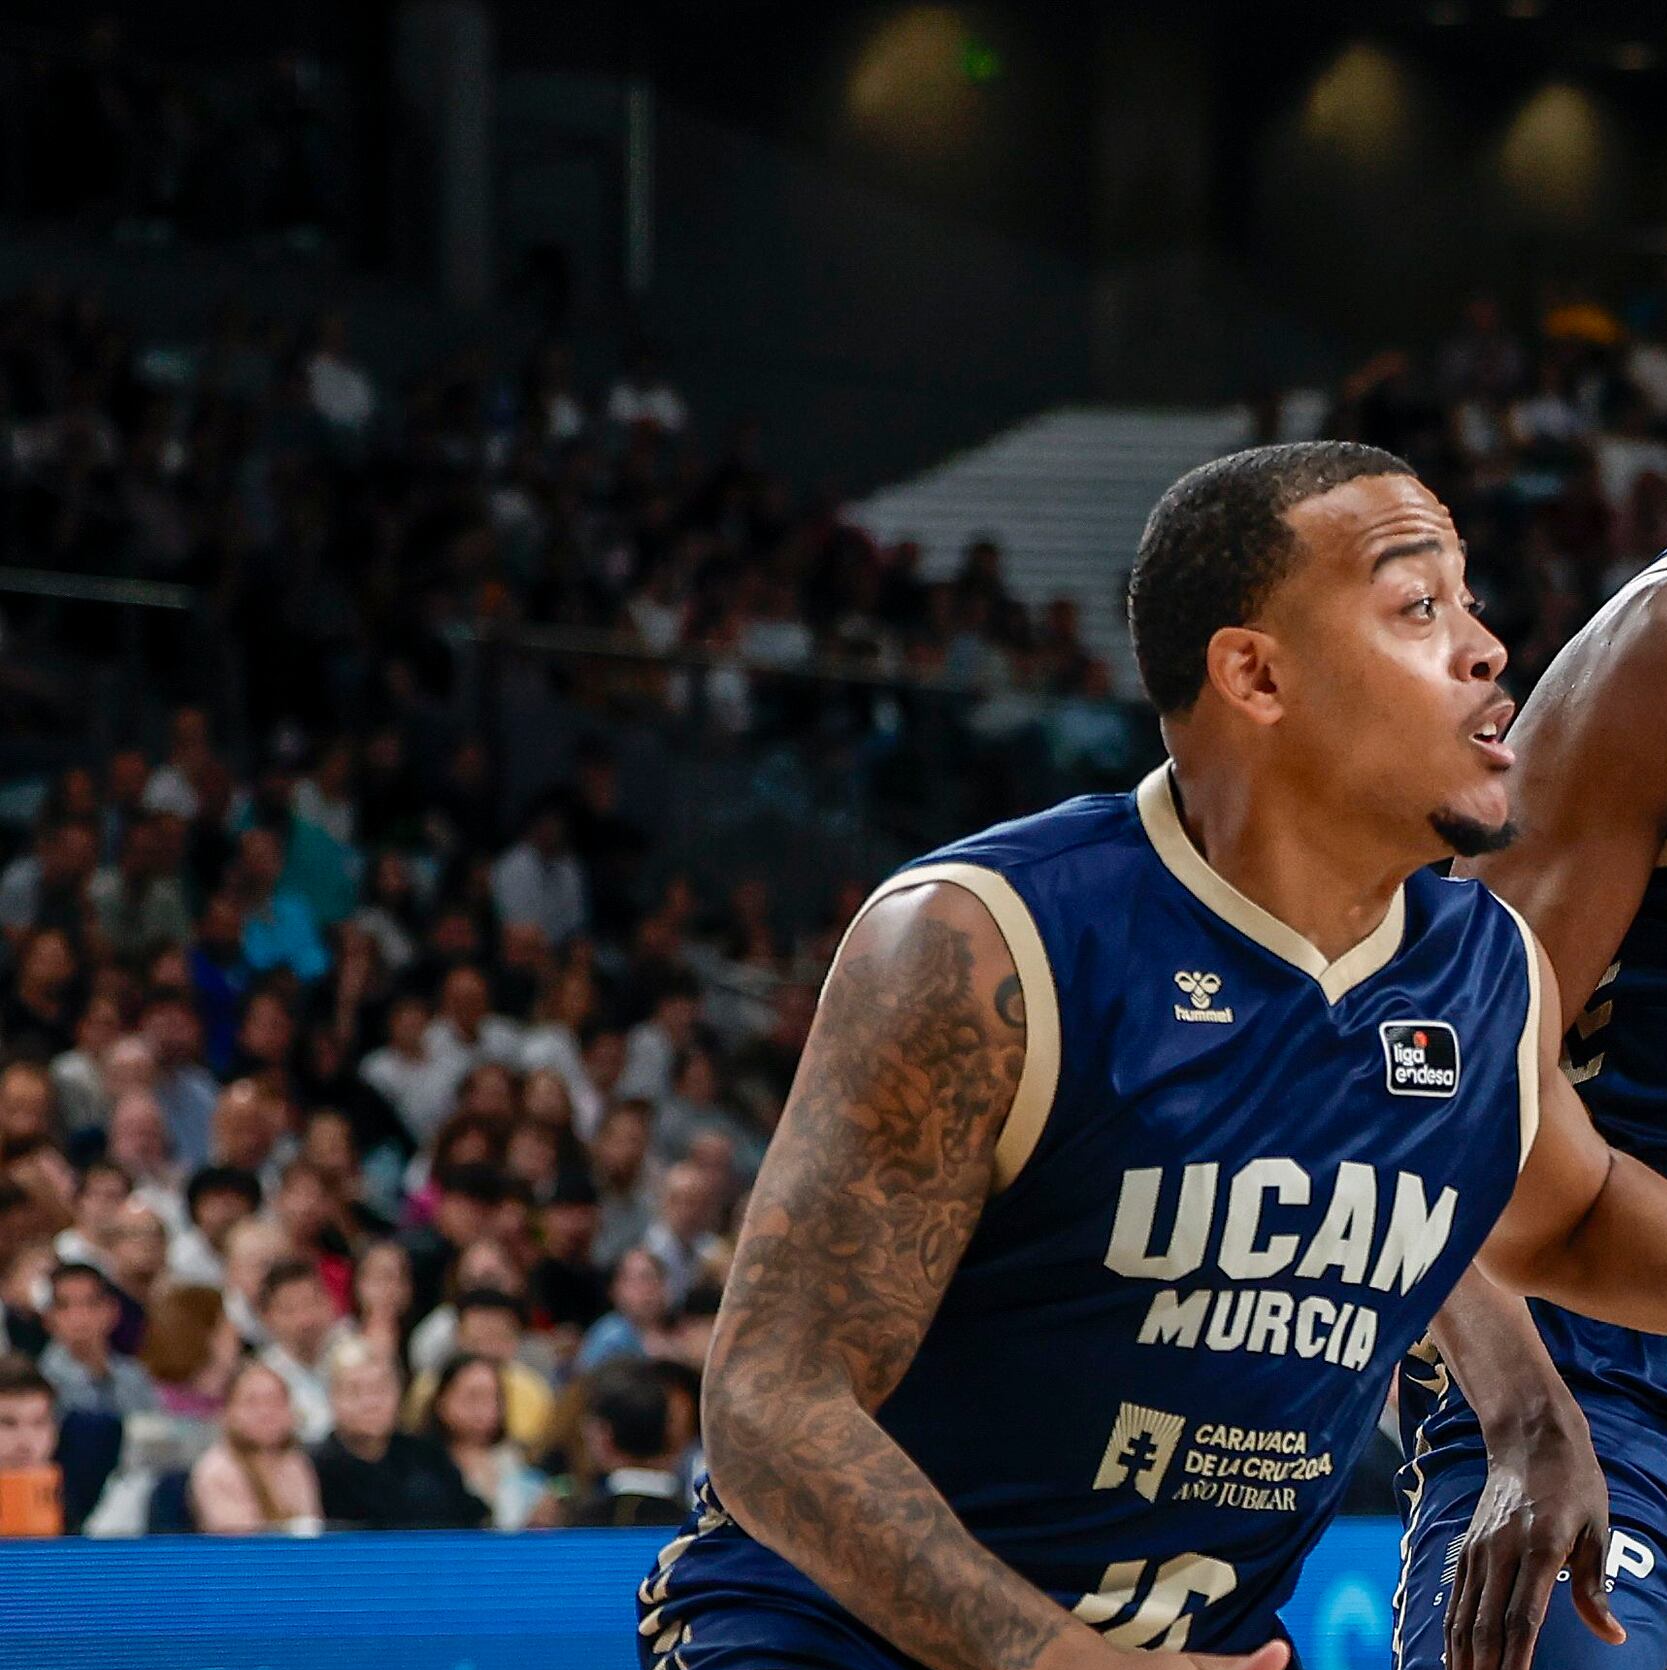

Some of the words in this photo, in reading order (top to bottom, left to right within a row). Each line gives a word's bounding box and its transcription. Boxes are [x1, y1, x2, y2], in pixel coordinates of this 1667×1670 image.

[1174, 1003, 1233, 1023] hummel
[1393, 1041, 1425, 1067] liga
[1395, 1065, 1455, 1090] endesa
[1105, 1157, 1458, 1297] UCAM
[1137, 1289, 1380, 1371] MURCIA
[1195, 1424, 1307, 1455] CARAVACA
[1184, 1450, 1217, 1477] DE
[1242, 1456, 1292, 1482] CRU
[1172, 1479, 1217, 1500] AÑO
